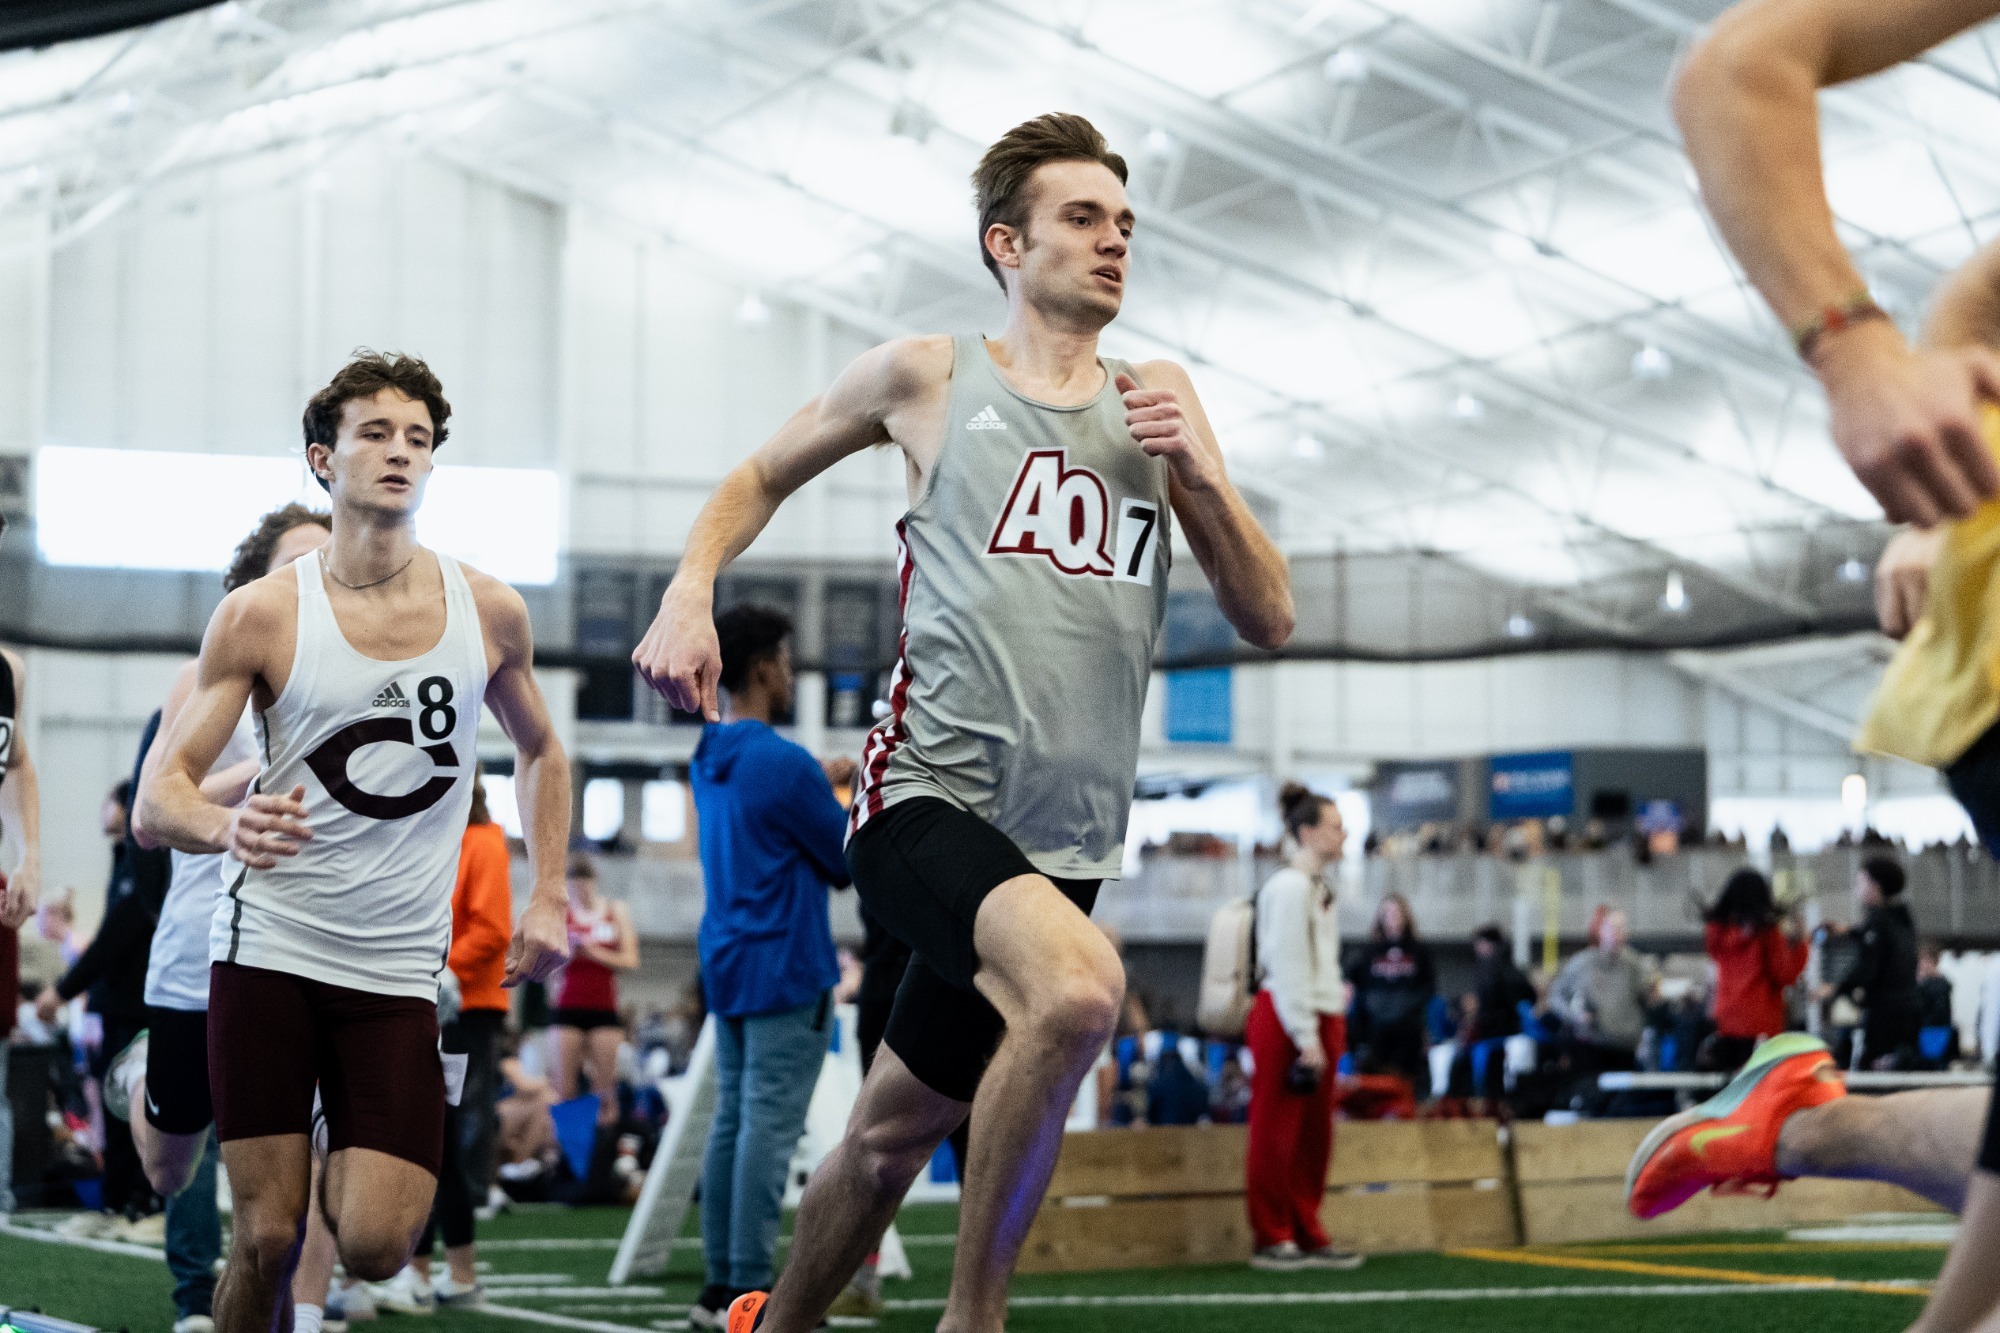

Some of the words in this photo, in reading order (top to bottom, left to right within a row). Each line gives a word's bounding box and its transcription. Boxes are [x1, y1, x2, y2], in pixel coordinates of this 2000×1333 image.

[965, 420, 1007, 430] adidas
[983, 447, 1115, 578] AQ
[1126, 506, 1156, 577] 7
[372, 698, 410, 708] adidas
[418, 676, 456, 740] 8
[303, 717, 460, 820] C
